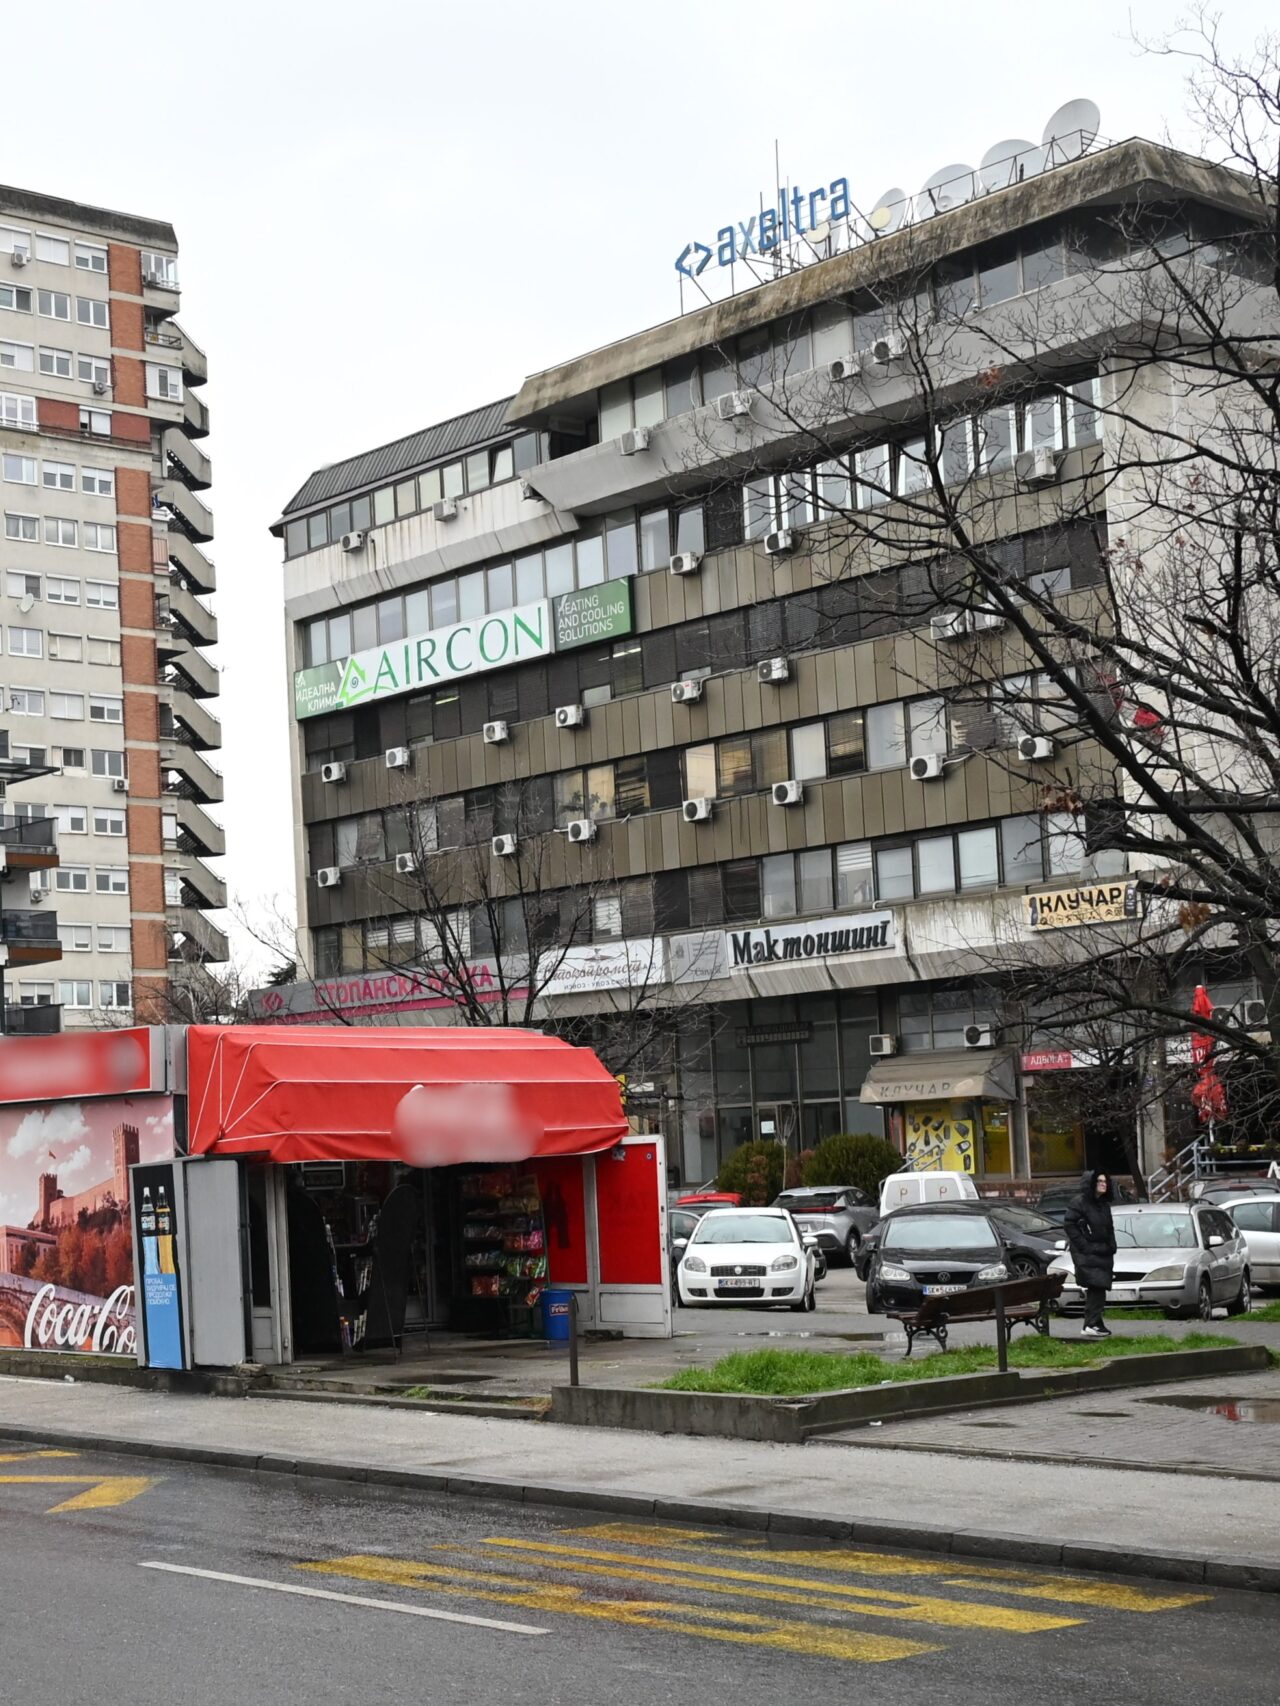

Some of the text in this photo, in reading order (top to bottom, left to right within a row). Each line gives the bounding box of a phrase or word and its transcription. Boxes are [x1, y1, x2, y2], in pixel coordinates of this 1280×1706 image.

[718, 177, 850, 267] axeltra
[558, 595, 599, 616] HEATING
[559, 601, 625, 631] AND COOLING
[559, 618, 613, 643] SOLUTIONS
[373, 606, 544, 694] AIRCON
[295, 681, 336, 703] ИДЕАЛНА
[308, 694, 338, 712] КЛИМА
[1039, 887, 1122, 914] КЛУЧАР
[315, 974, 423, 1006] СТОПАНСКА
[24, 1283, 137, 1353] Coca-Co
